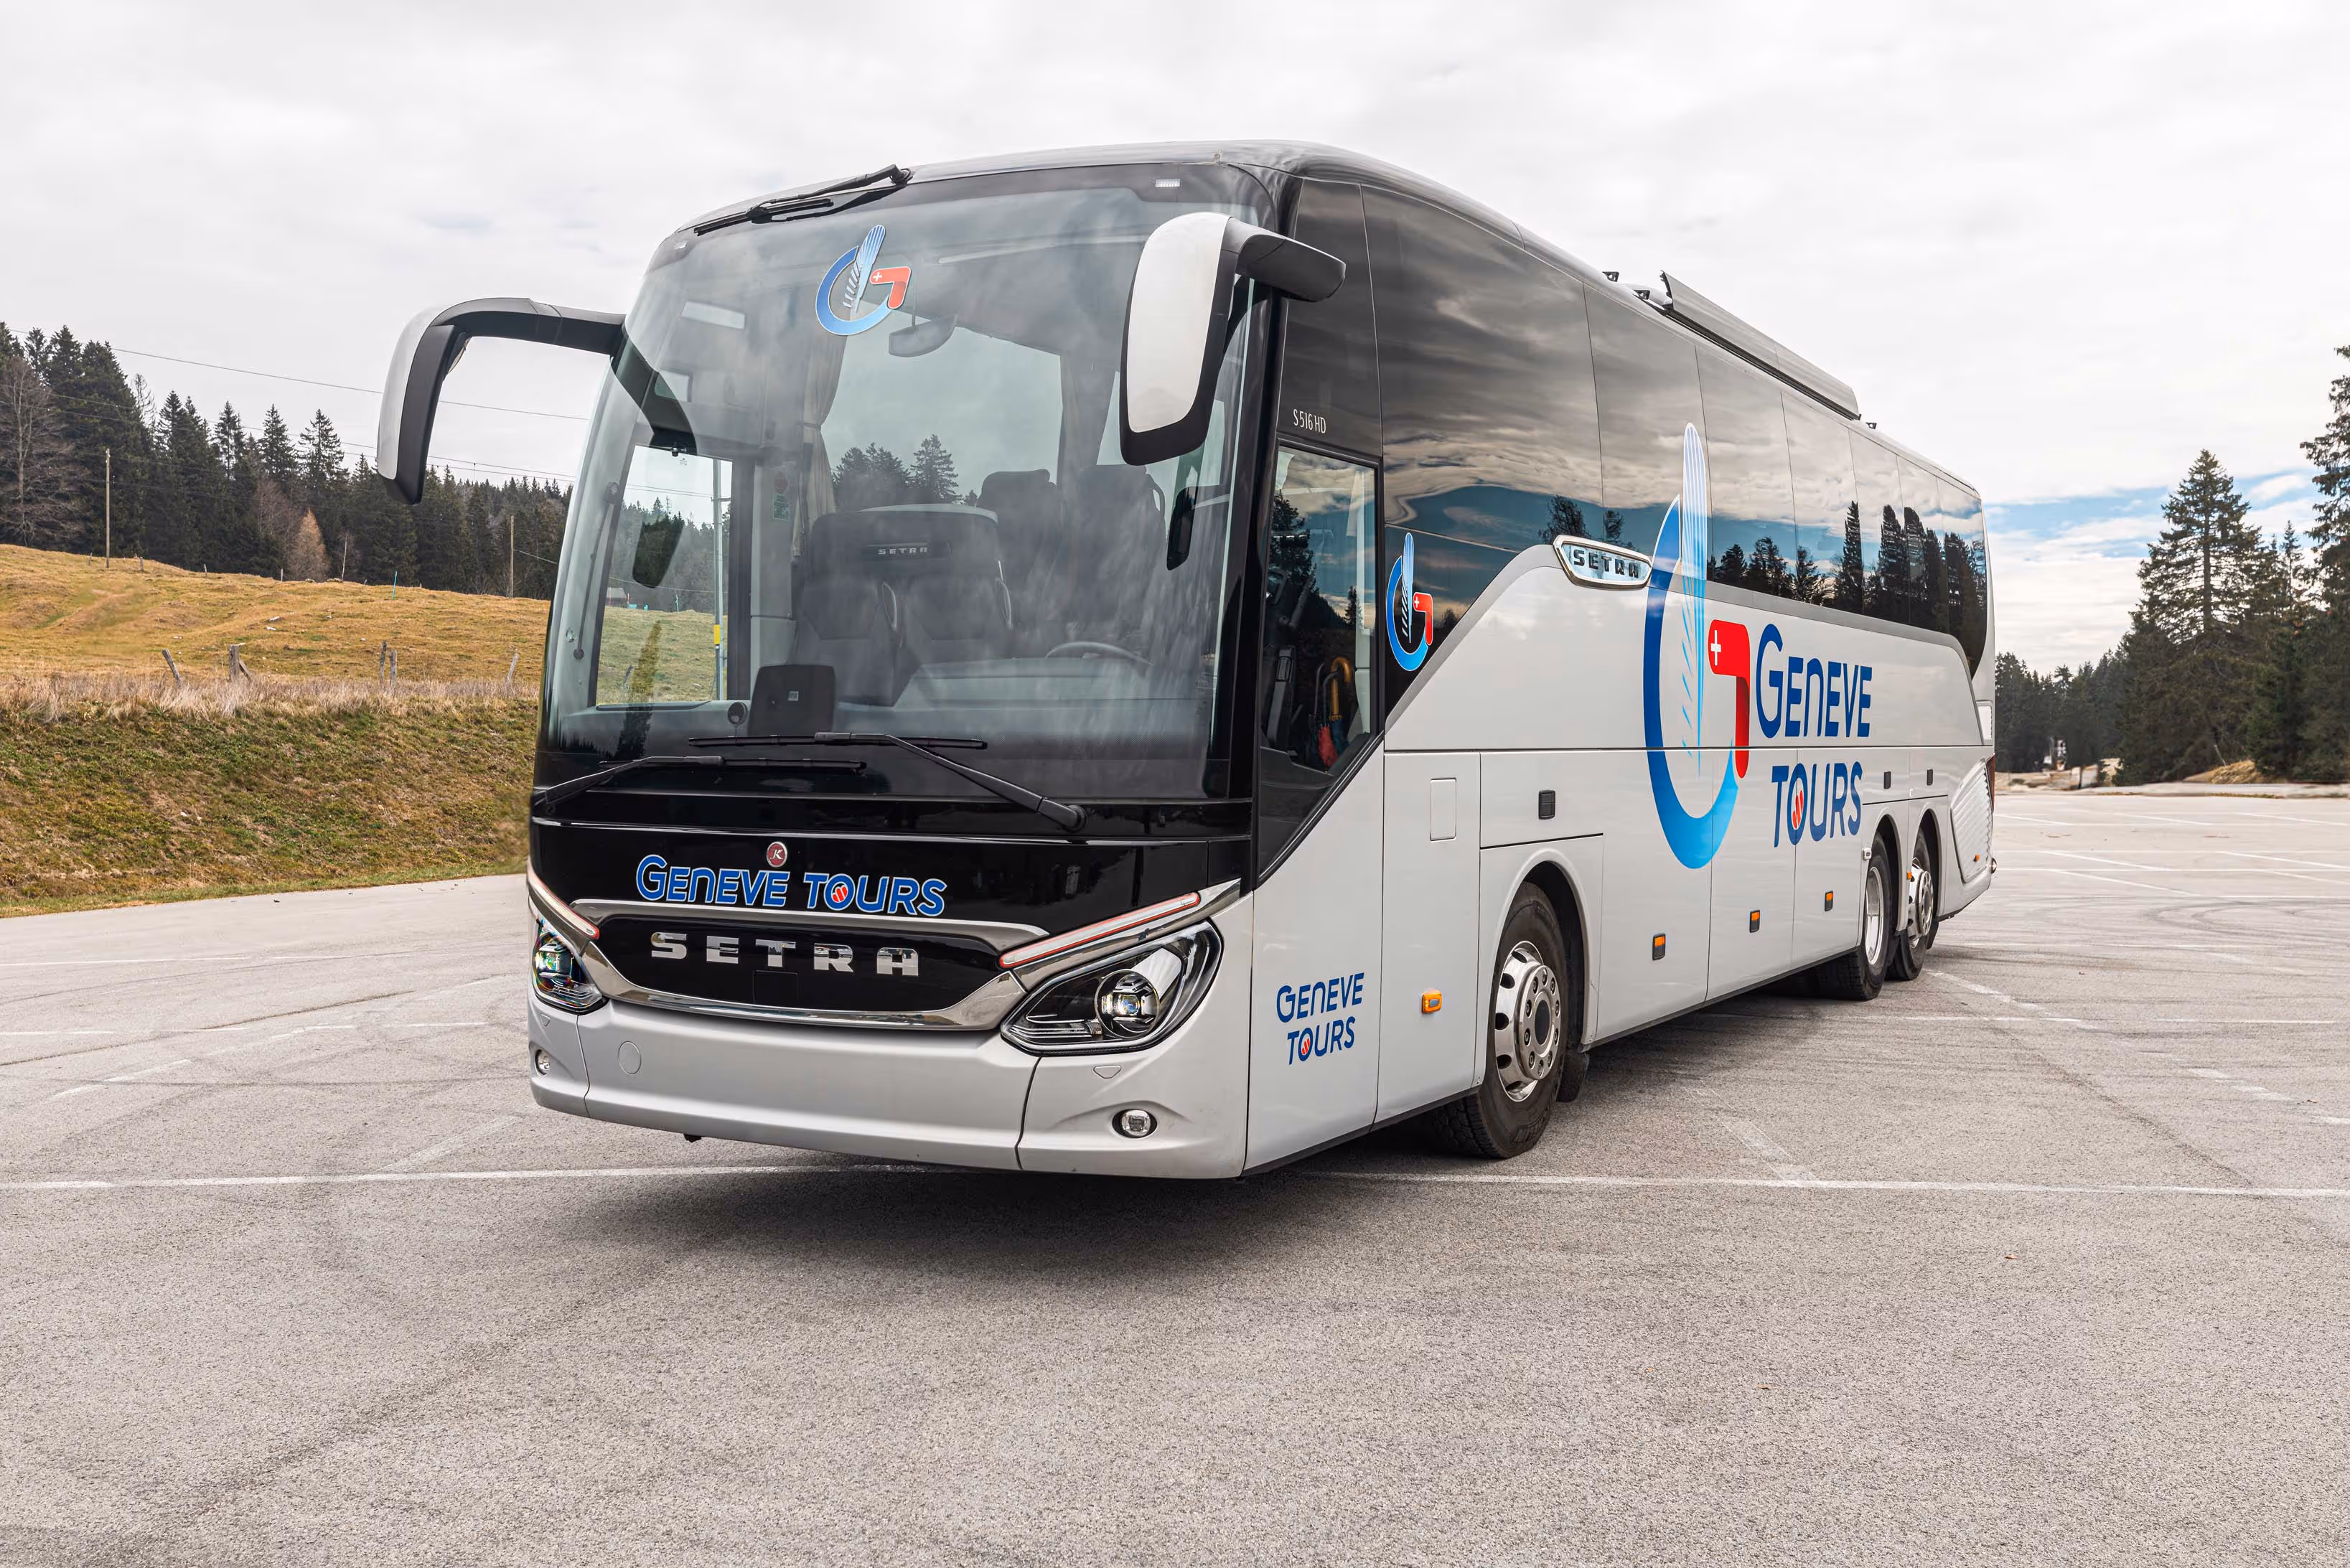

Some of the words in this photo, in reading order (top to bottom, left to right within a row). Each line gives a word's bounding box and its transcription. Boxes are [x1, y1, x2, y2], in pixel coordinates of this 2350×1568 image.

[1293, 408, 1298, 426] S
[1299, 410, 1313, 431] 516
[1314, 415, 1326, 434] HD
[1573, 549, 1639, 578] SETRA
[1771, 761, 1863, 848] TOURS
[804, 872, 947, 916] TOURS
[650, 931, 919, 977] SETRA
[1287, 1015, 1356, 1066] TOURS
